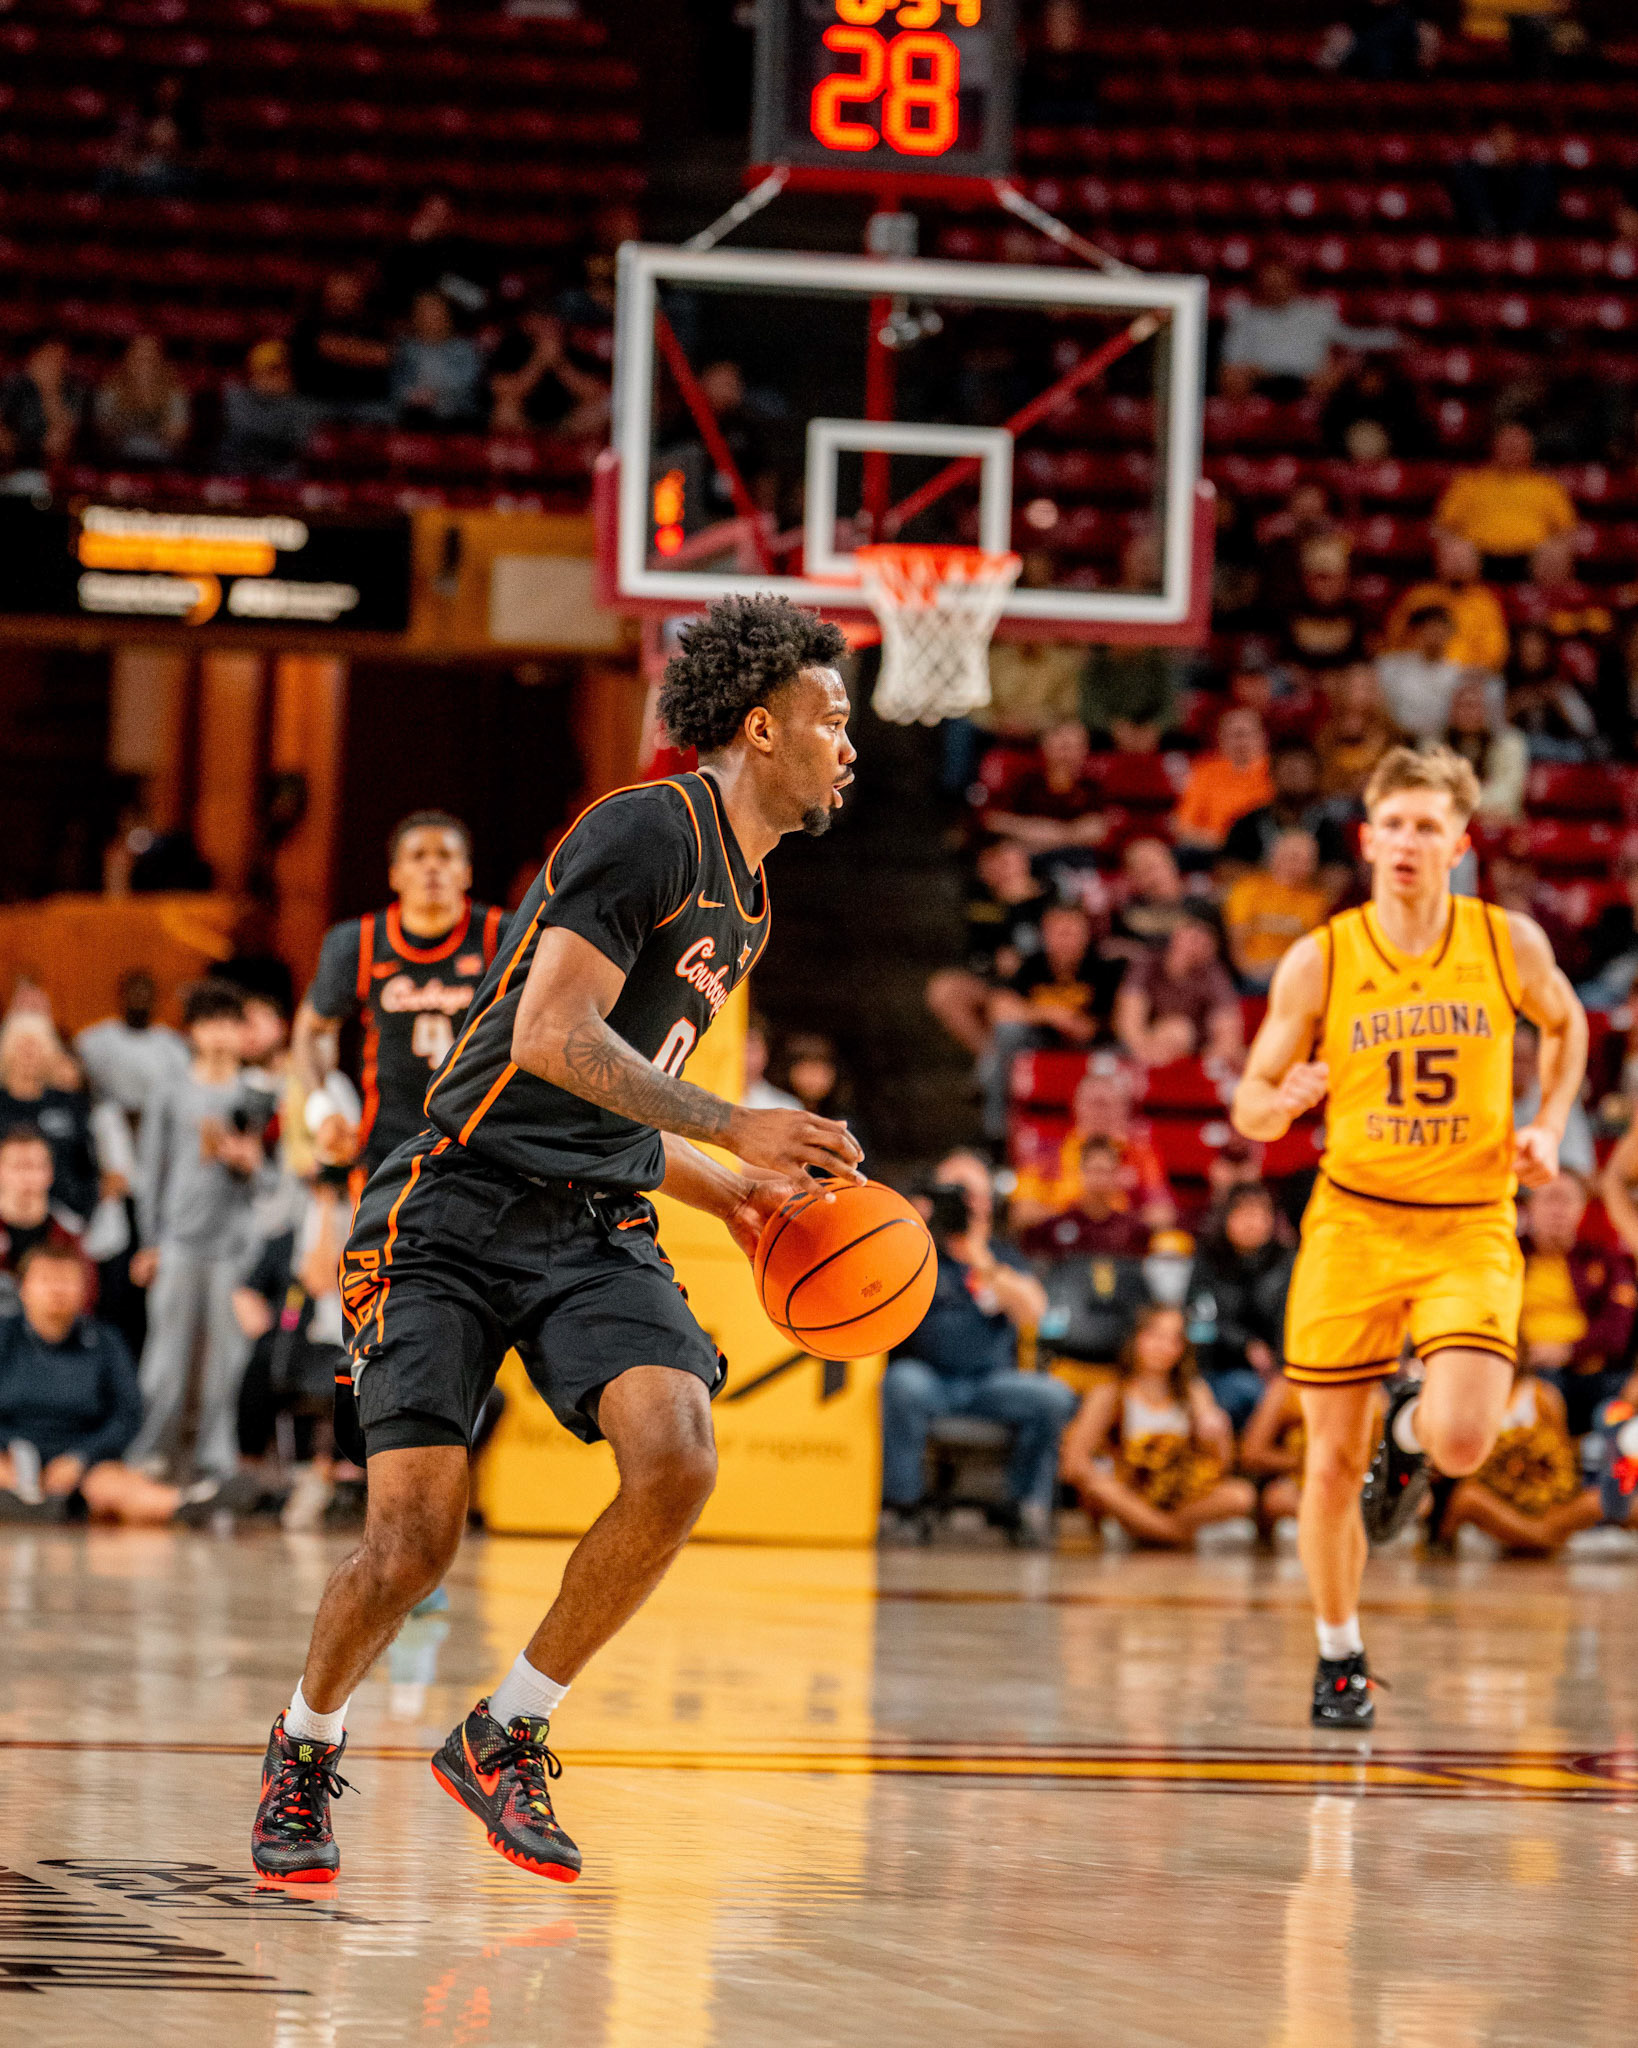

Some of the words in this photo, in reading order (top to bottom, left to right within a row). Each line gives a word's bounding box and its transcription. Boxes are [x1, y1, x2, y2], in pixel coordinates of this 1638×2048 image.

[811, 24, 960, 157] 28
[1352, 1002, 1492, 1053] ARIZONA
[1386, 1048, 1458, 1107] 15
[1367, 1114, 1470, 1147] STATE
